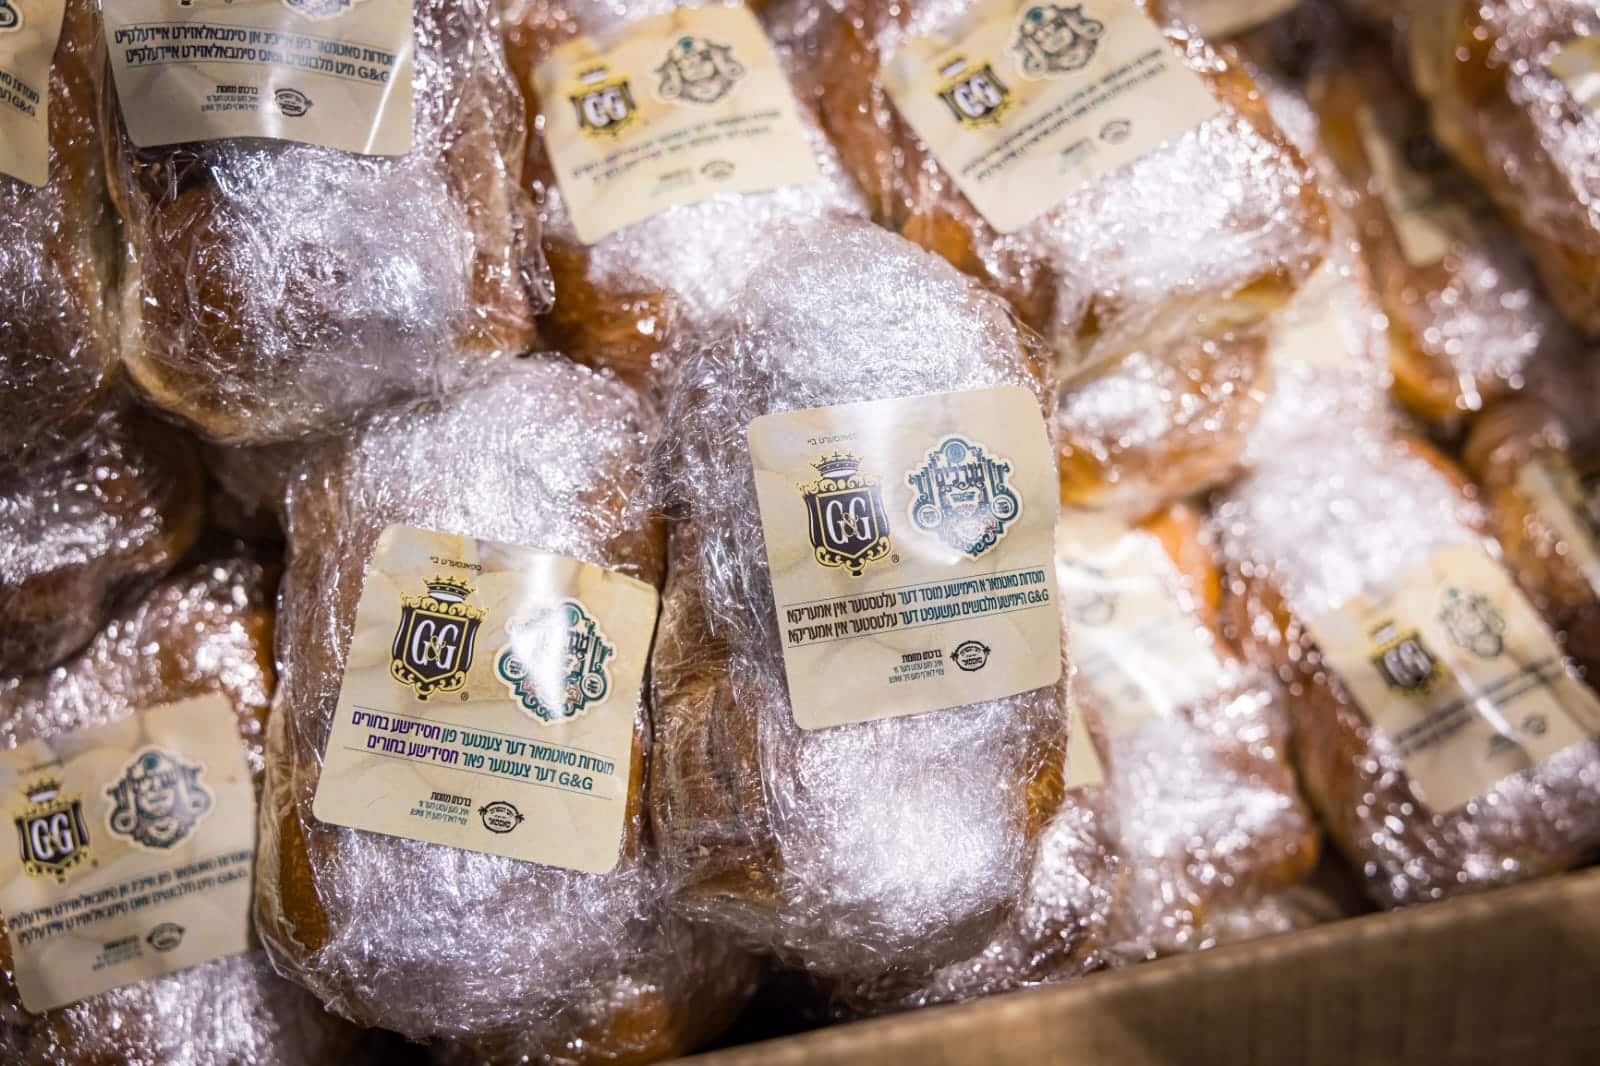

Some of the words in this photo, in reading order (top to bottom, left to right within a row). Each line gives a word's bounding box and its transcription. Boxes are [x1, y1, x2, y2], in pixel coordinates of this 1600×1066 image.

[363, 49, 396, 66] וסדות
[828, 497, 872, 547] G&G
[1019, 570, 1046, 586] מוסדות
[848, 592, 897, 613] עלטסטער
[898, 591, 917, 605] דער
[919, 586, 943, 601] מוסד
[1028, 589, 1049, 603] G&G
[787, 603, 832, 624] אמעריקא
[832, 601, 847, 618] אין
[899, 610, 918, 625] דער
[920, 602, 961, 621] געשעפט
[834, 621, 848, 638] אין
[850, 612, 897, 633] עלטסטער
[788, 623, 833, 644] אמעריקא
[411, 620, 458, 671] G&G
[352, 711, 389, 731] בחורים
[390, 719, 440, 740] חסידישע
[367, 735, 406, 754] בחורים
[441, 728, 457, 743] פון
[460, 731, 503, 752] צענטער
[407, 742, 459, 764] חסידישע
[505, 740, 526, 756] דער
[529, 744, 576, 766] סאטמאר
[462, 752, 484, 768] פאר
[488, 757, 531, 777] צענטער
[578, 755, 615, 775] מוסדות
[534, 765, 556, 781] דער
[559, 772, 593, 790] G&G
